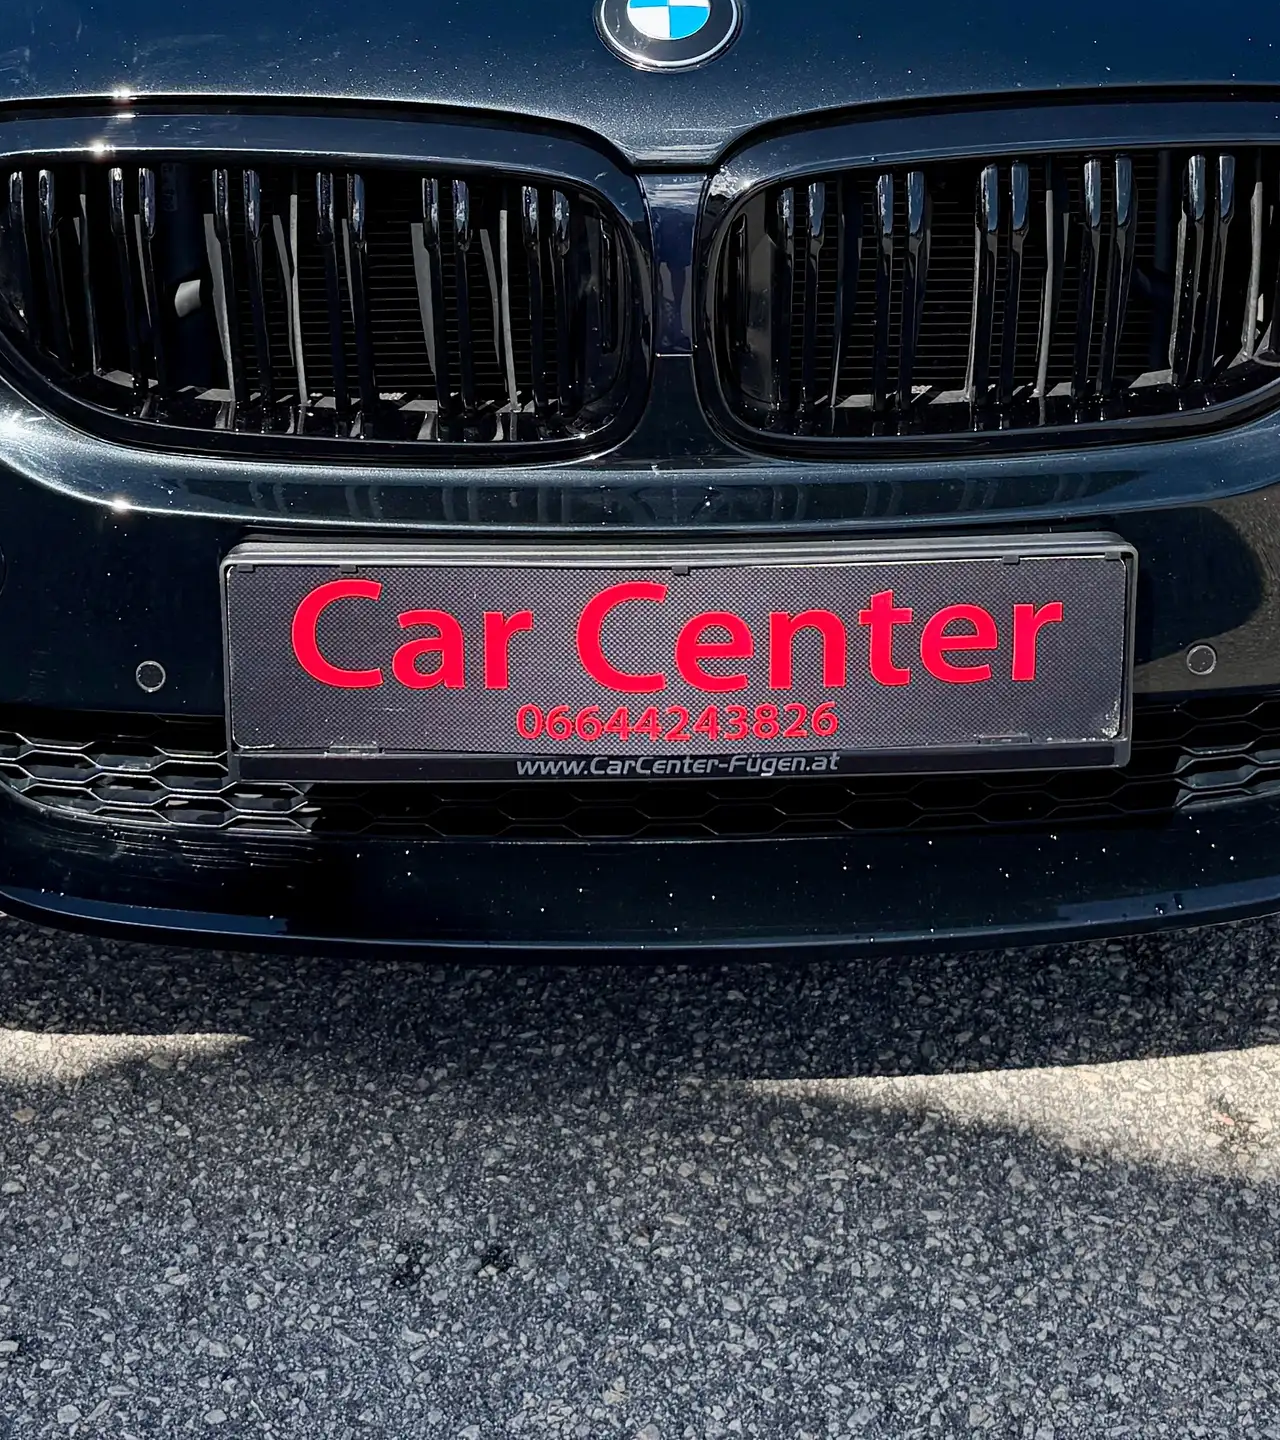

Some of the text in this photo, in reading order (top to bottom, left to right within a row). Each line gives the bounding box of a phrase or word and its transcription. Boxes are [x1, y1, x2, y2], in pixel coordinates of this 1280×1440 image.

[291, 577, 1064, 693] Car Center
[515, 700, 839, 742] 06644243826
[516, 751, 841, 777] www.CarCenter-Fügen.at
